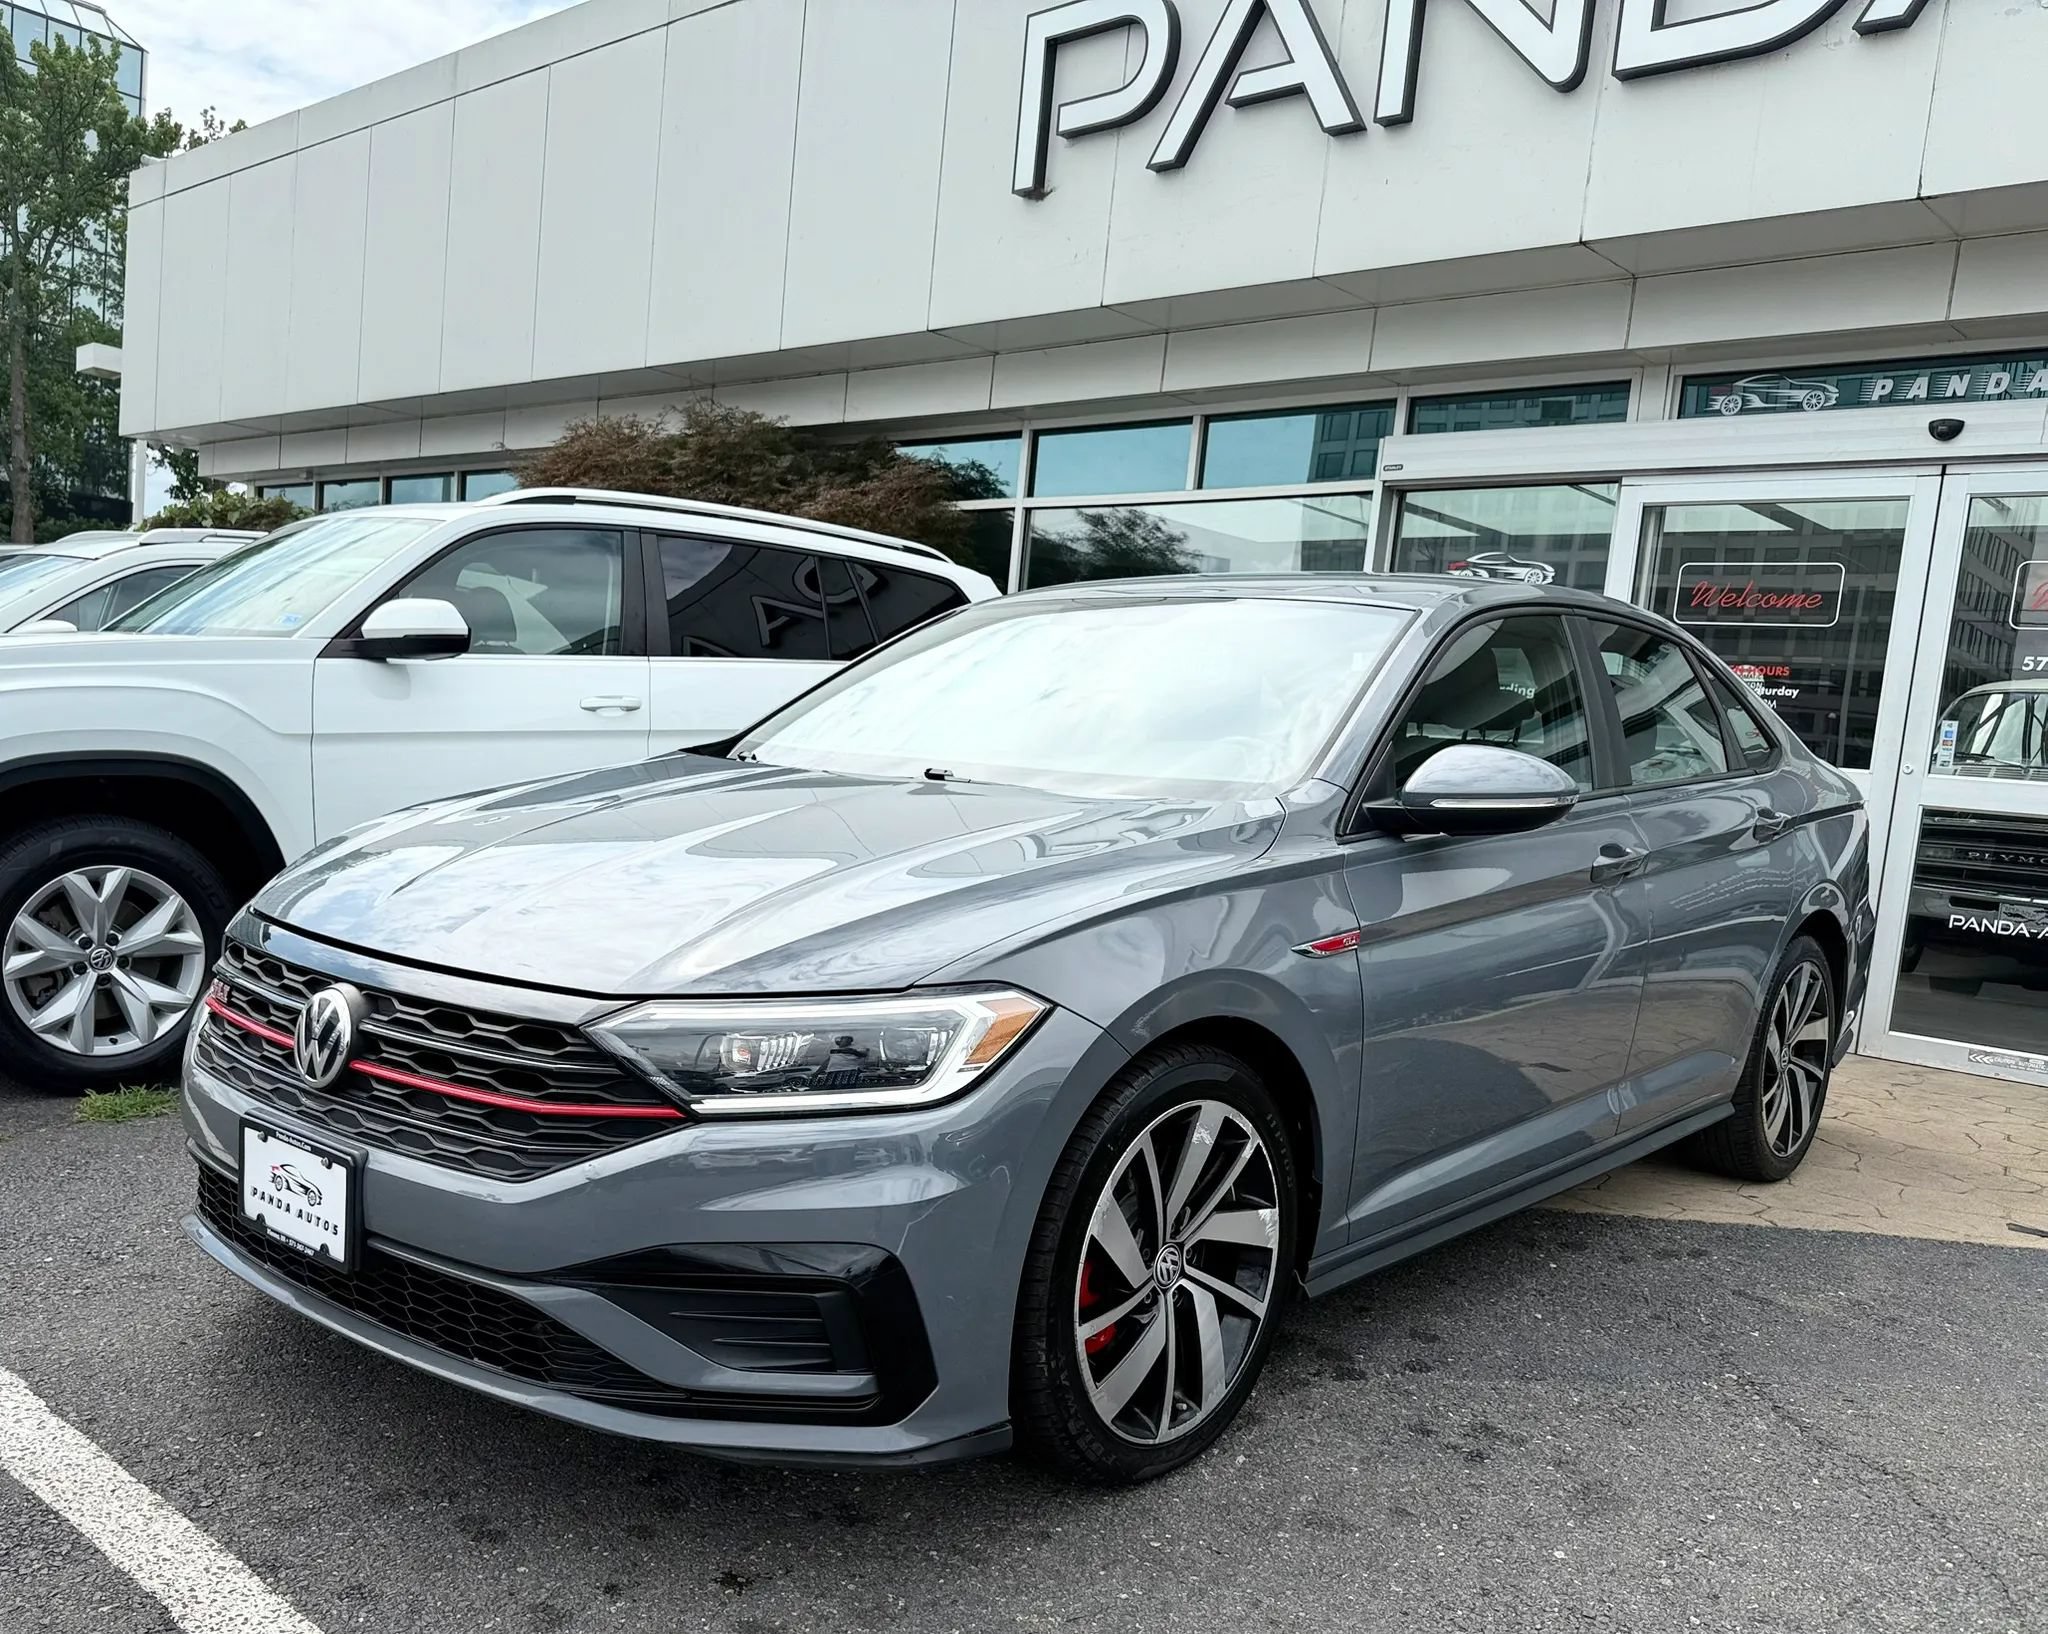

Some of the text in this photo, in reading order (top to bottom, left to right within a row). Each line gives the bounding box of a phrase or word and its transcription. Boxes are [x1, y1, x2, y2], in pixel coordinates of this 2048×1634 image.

[1862, 368, 2048, 401] PANDA
[1690, 580, 1824, 609] Welcome
[250, 1186, 339, 1236] PANDA AUTOS
